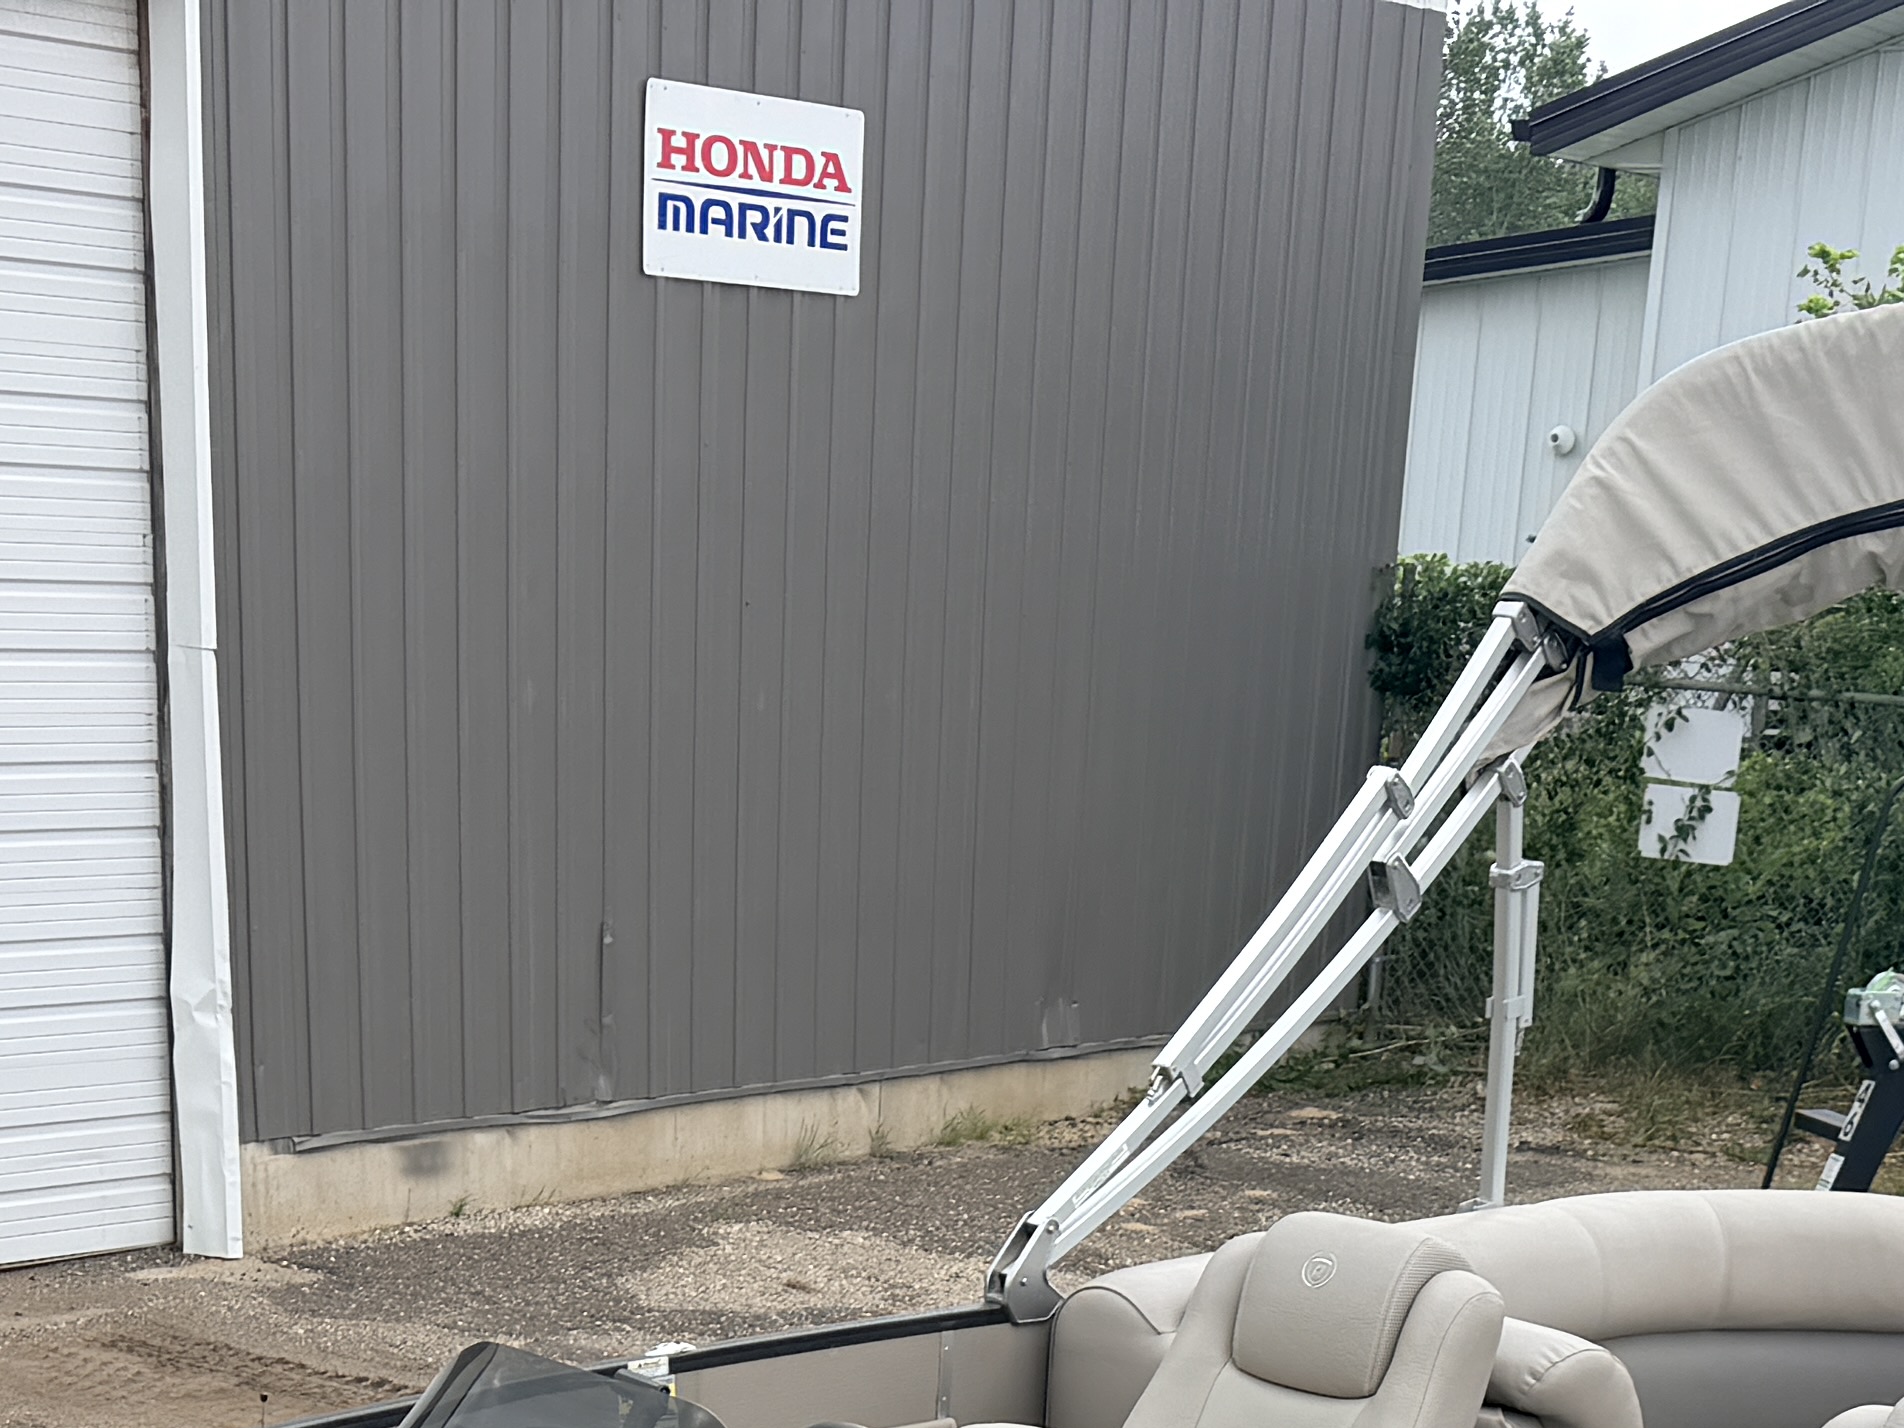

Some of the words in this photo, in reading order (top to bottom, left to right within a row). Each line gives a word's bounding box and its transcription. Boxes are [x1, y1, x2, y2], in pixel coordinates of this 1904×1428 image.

[656, 127, 852, 193] HONDA
[657, 192, 849, 251] MARINE
[1843, 1083, 1872, 1137] 46
